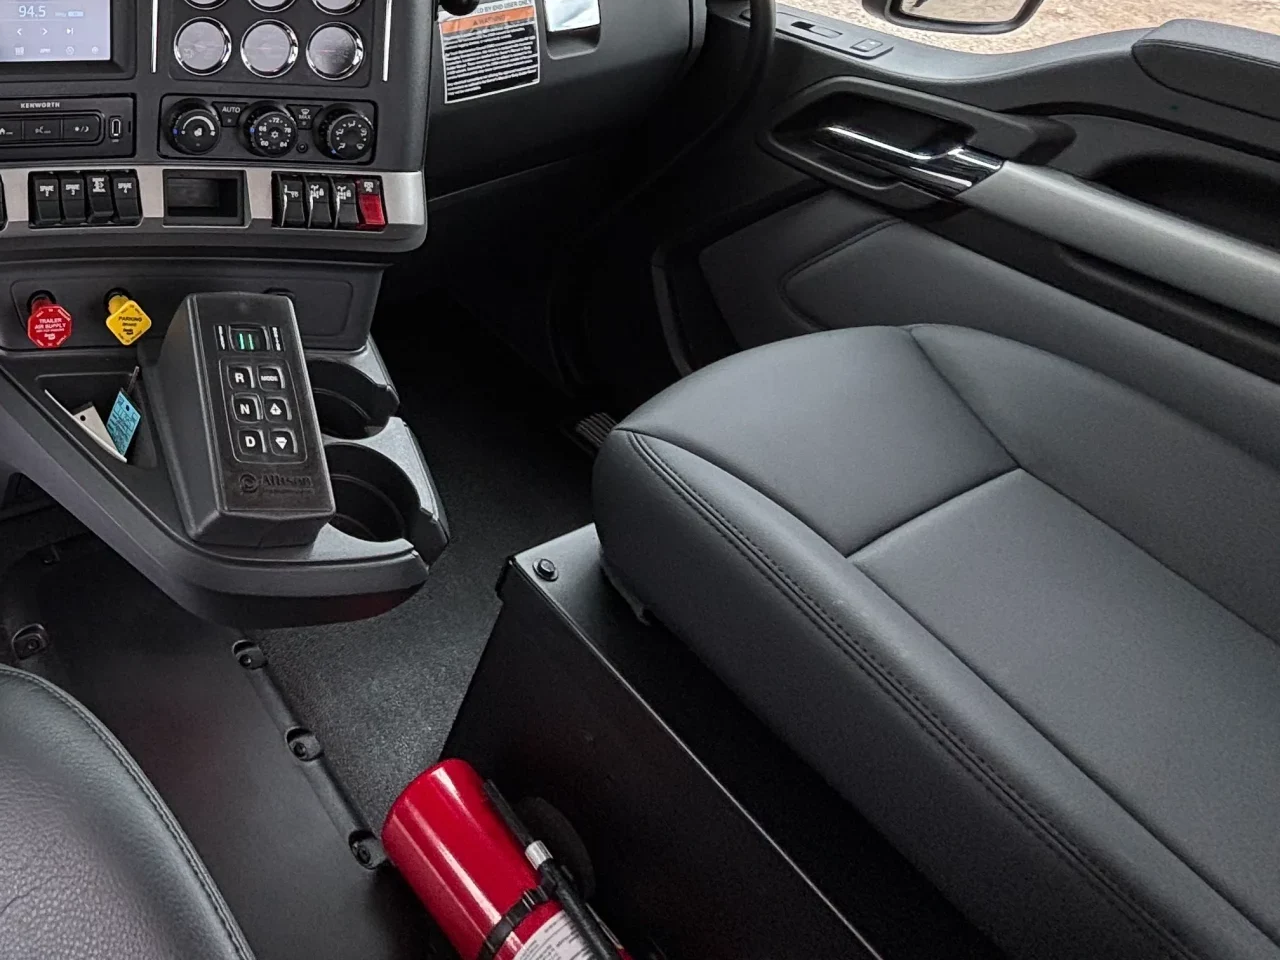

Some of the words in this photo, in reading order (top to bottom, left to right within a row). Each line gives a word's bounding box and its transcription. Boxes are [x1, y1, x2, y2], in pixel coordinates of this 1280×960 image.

[18, 5, 46, 18] 94.5
[234, 372, 245, 383] R
[240, 404, 250, 415] N
[245, 436, 255, 448] D
